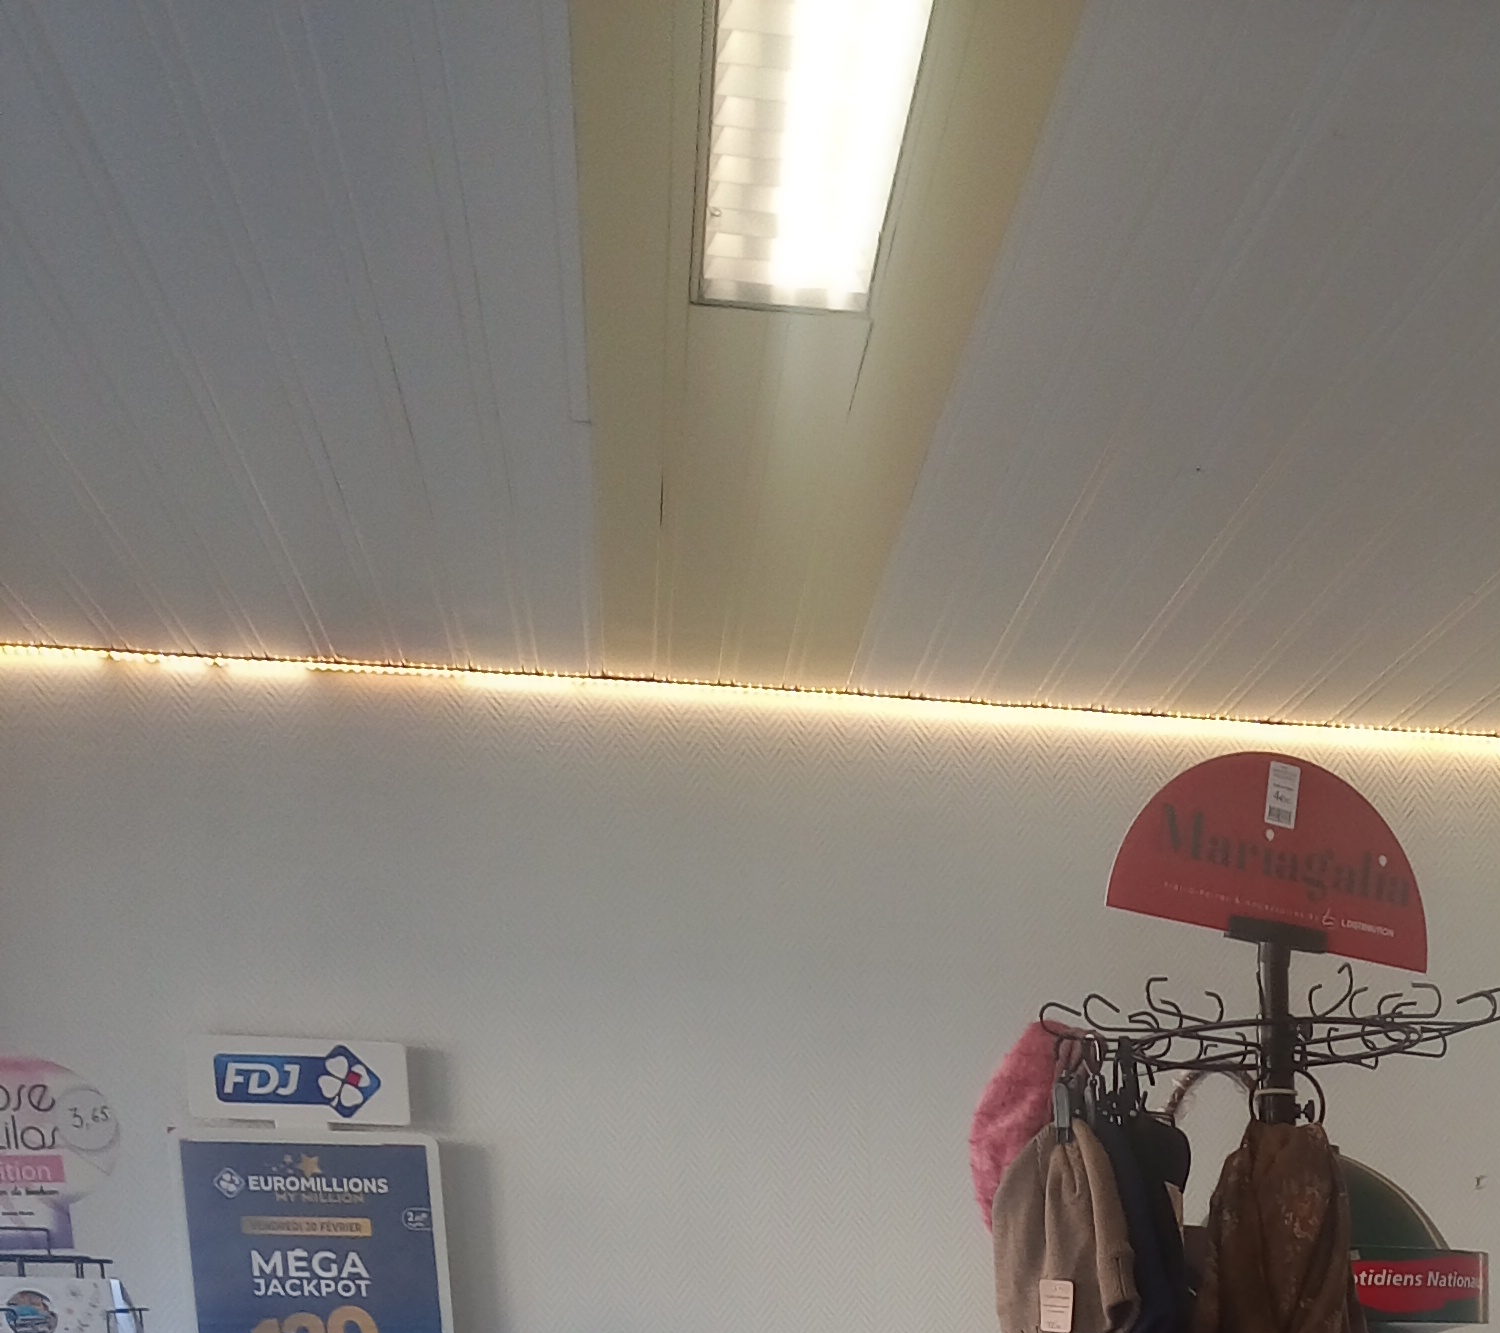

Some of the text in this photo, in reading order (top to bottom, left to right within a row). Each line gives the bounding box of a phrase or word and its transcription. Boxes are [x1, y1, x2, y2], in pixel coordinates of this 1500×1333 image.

[223, 1062, 301, 1097] FDJ
[248, 1175, 389, 1195] EUROMILLIONS
[302, 1192, 365, 1204] MILLION
[250, 1246, 371, 1279] MÉGA
[1354, 1269, 1423, 1287] tidiens
[253, 1279, 372, 1298] JACKPOT
